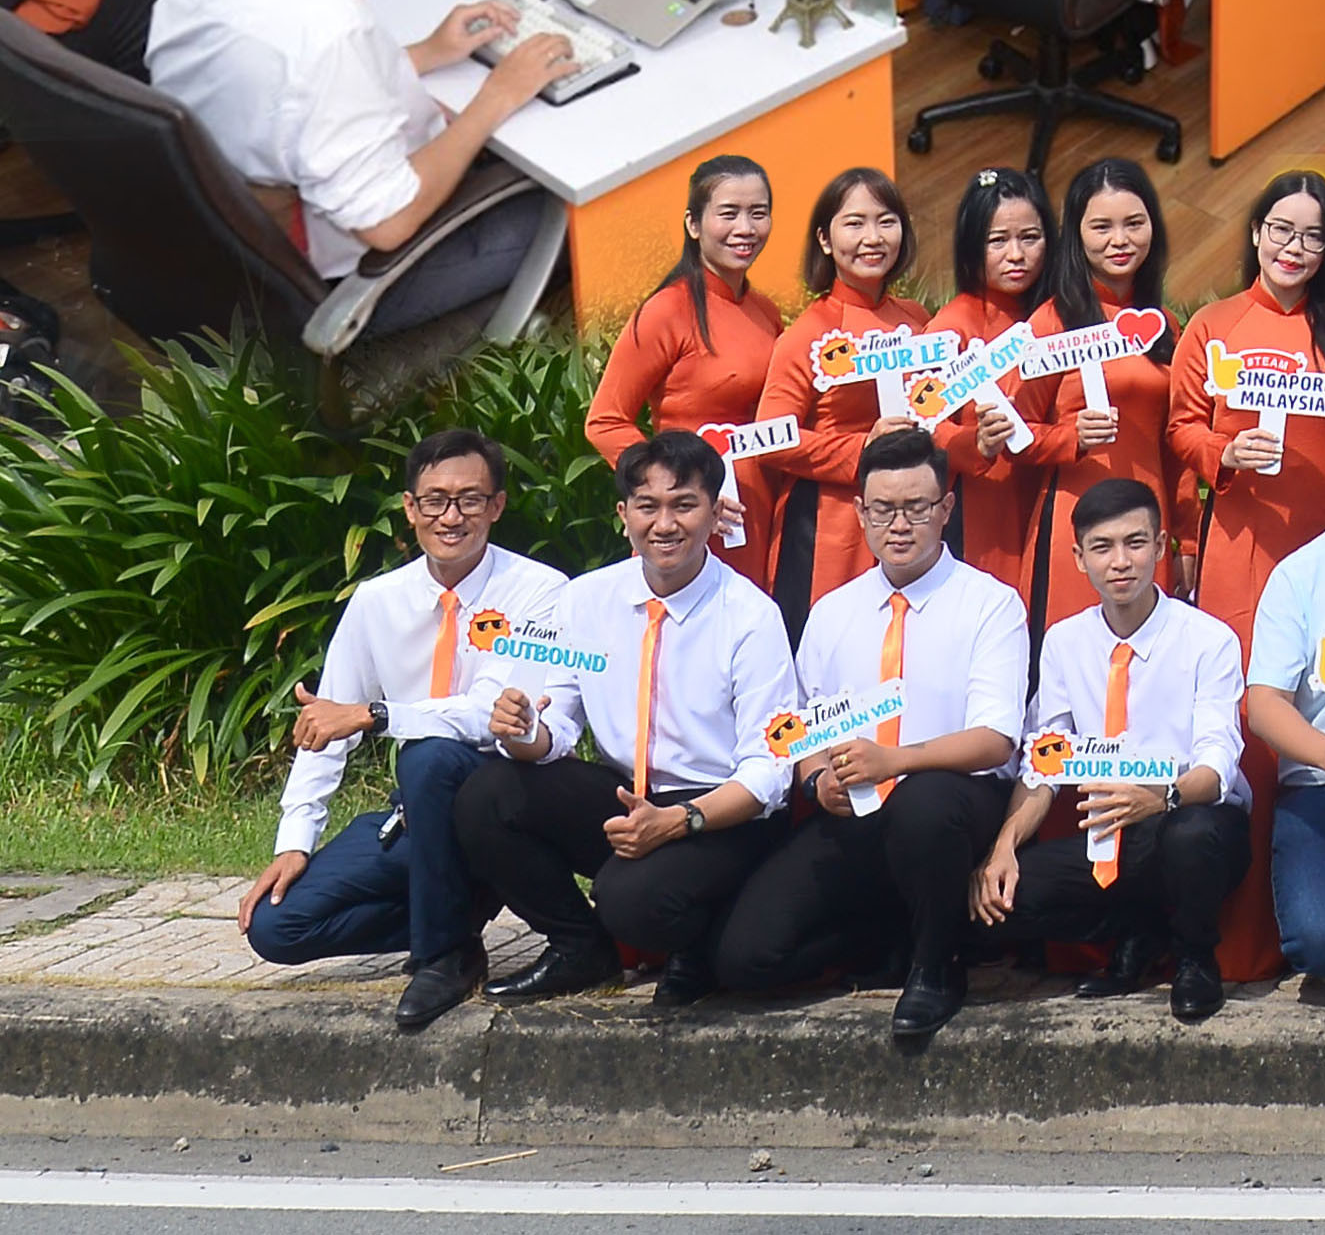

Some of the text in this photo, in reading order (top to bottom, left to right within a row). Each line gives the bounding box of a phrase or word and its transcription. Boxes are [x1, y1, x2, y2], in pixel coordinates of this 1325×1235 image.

[1021, 335, 1145, 377] CAMBODIA
[1047, 329, 1111, 353] HAIDANG
[852, 348, 914, 376] TOUR
[941, 366, 992, 406] TOUR
[1240, 391, 1325, 412] MALAYSIA
[730, 422, 793, 454] BALI
[493, 637, 607, 673] OUTBOUND
[1062, 757, 1174, 778] TOUR ĐOÀN
